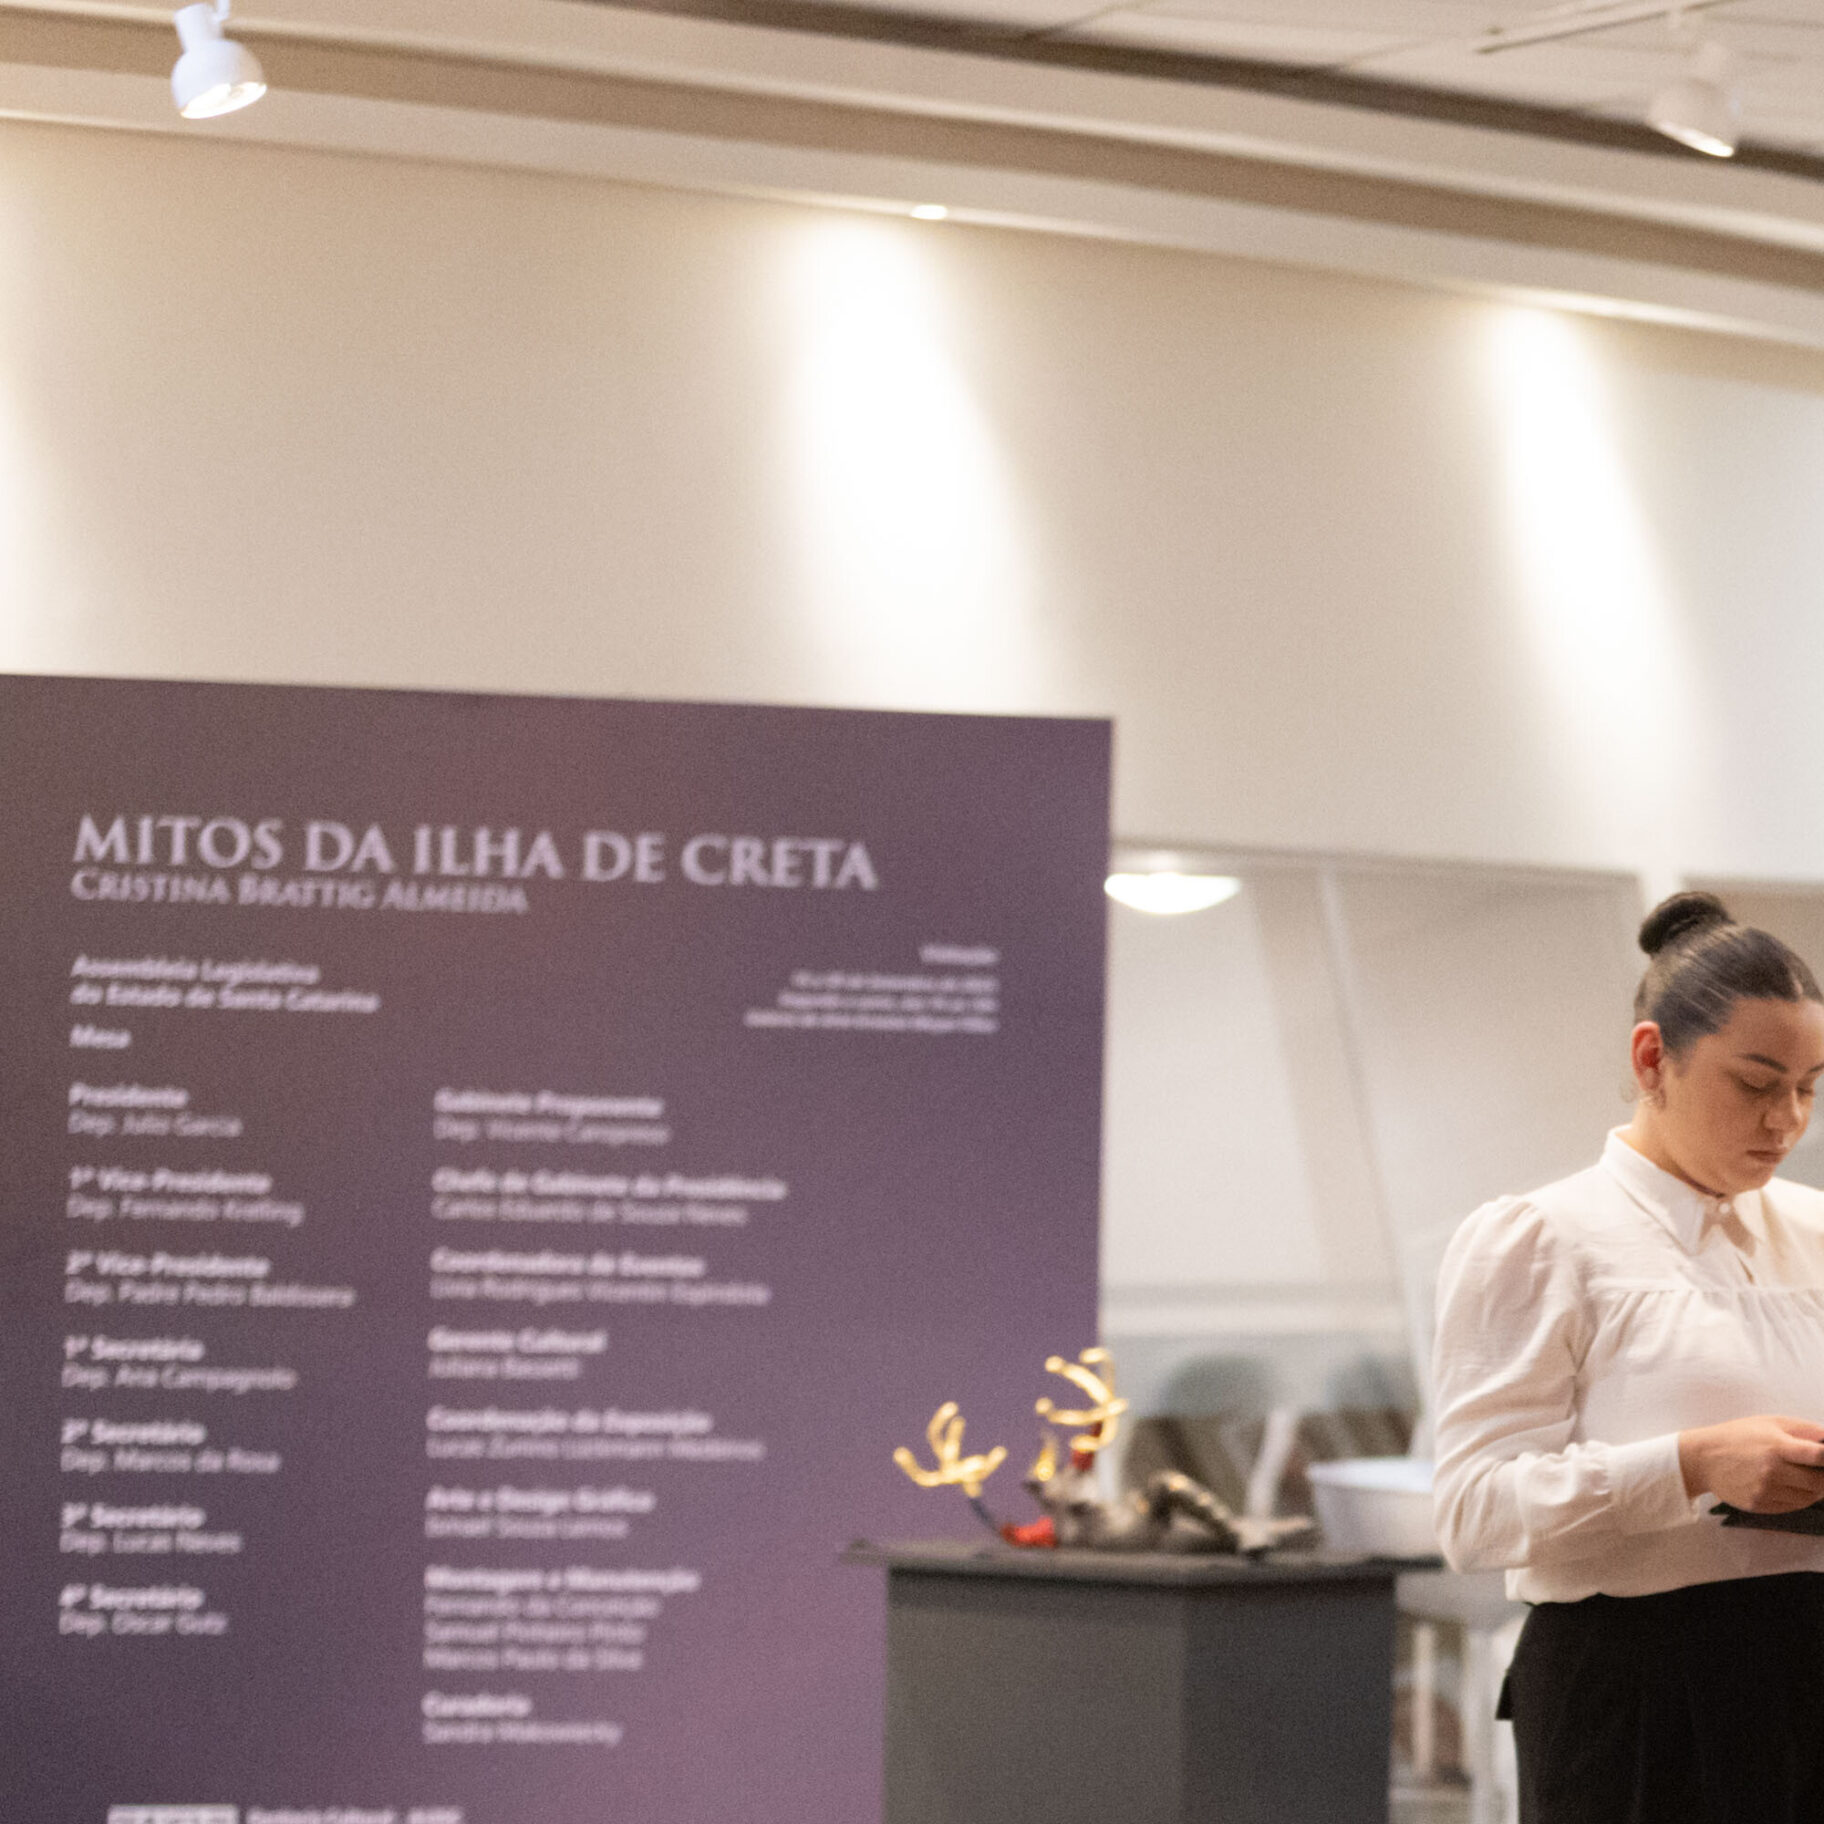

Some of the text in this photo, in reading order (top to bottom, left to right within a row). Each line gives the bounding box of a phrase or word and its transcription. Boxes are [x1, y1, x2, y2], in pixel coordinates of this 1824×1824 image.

[73, 816, 878, 890] MITOS DA ILHA DE CRETA
[69, 869, 230, 903] CRISTINA
[381, 881, 528, 914] ALMEIDA
